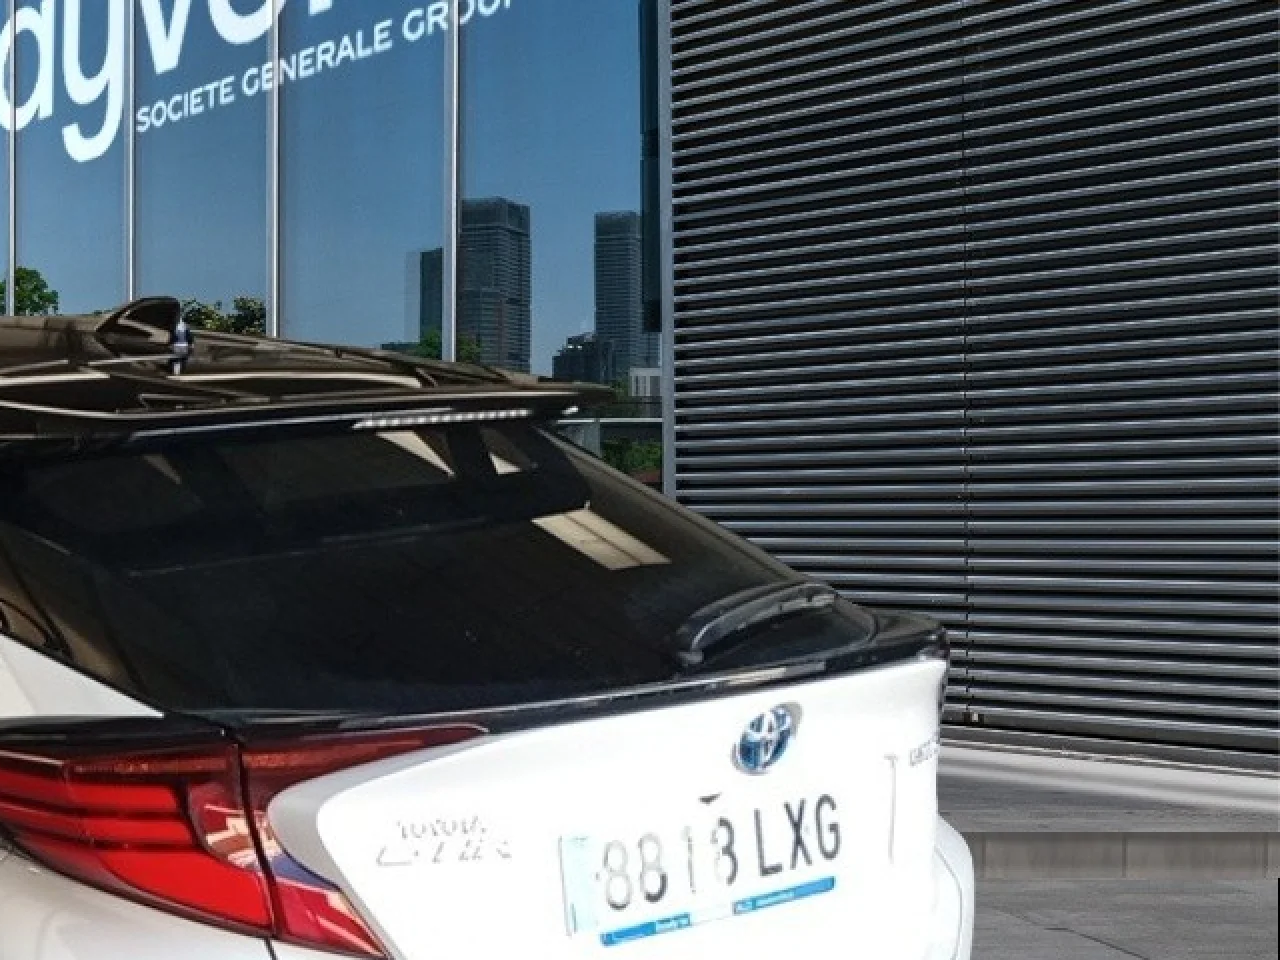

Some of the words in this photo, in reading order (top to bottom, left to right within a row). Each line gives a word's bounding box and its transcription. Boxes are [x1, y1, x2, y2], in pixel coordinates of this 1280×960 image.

[135, 76, 237, 133] SOCIETE
[241, 19, 394, 97] GENERALE
[753, 794, 841, 877] LXG
